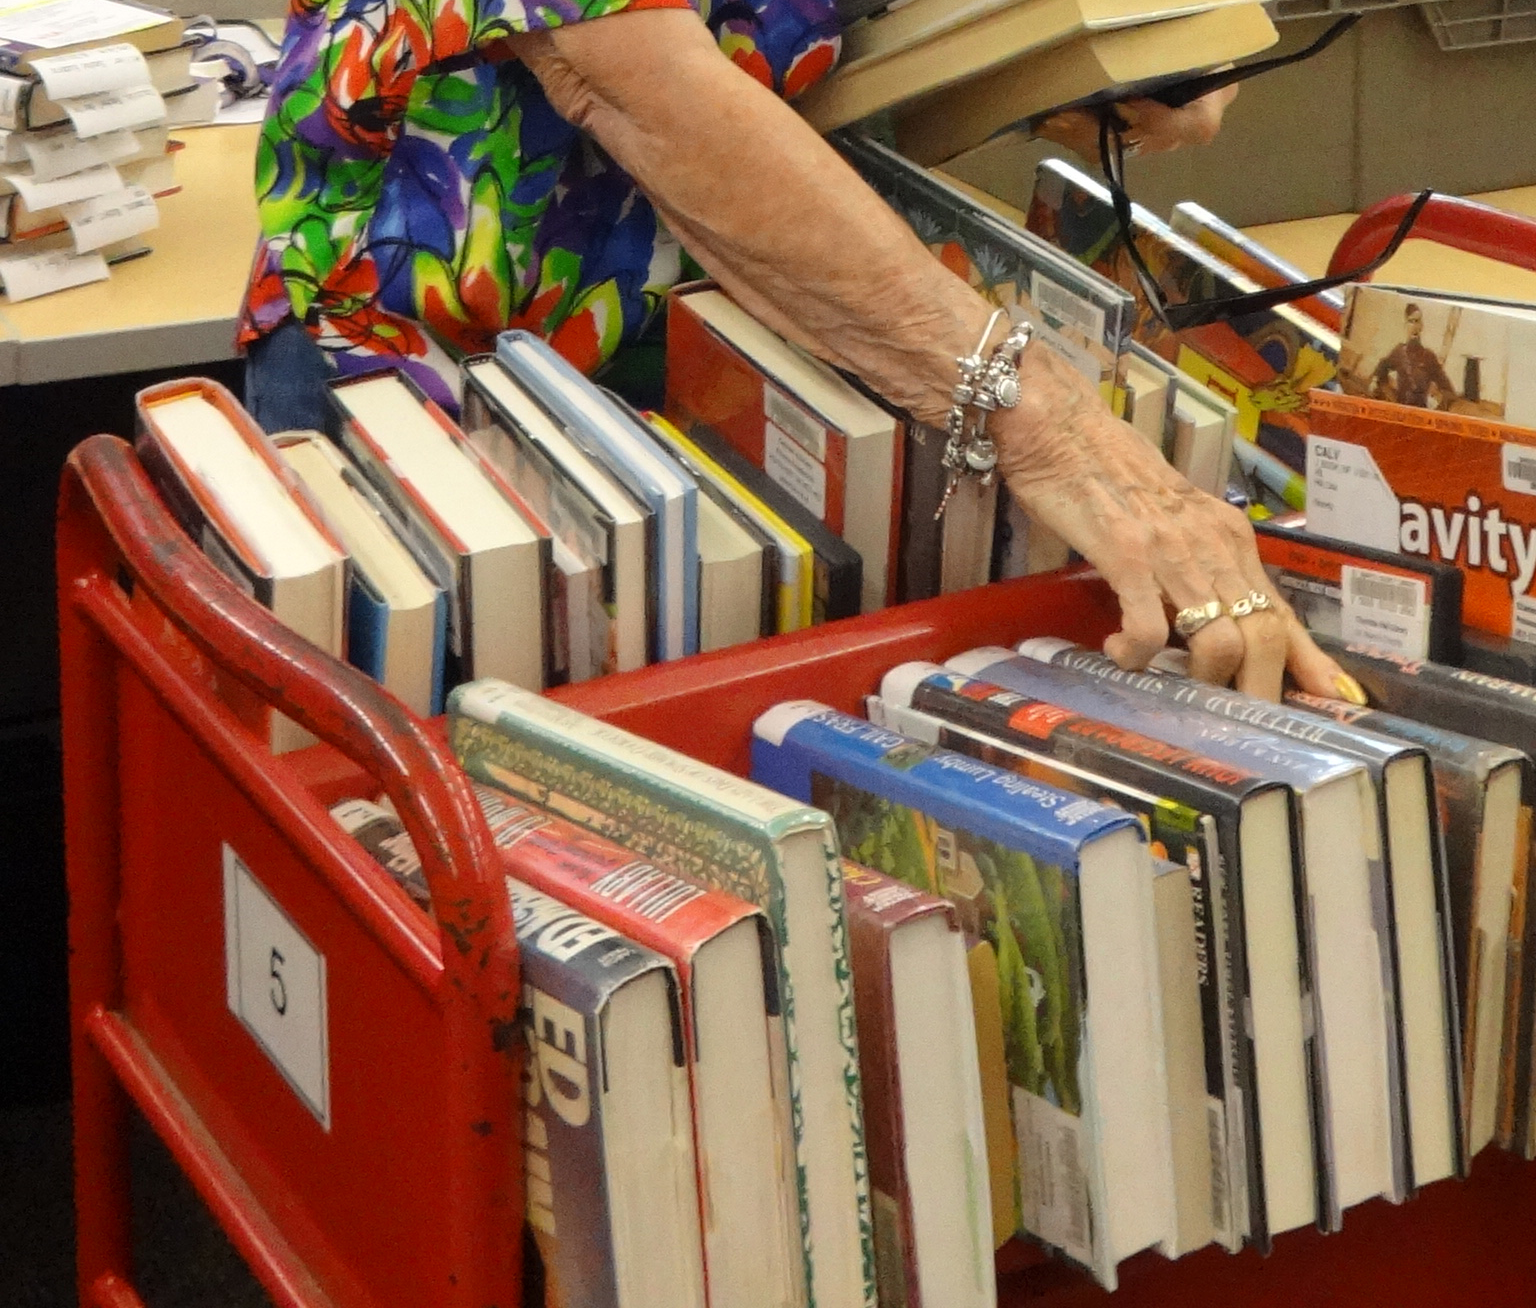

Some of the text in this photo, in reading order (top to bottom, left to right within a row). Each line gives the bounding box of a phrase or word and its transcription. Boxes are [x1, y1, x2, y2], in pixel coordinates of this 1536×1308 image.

[932, 753, 1067, 809] Stealing Lumby
[537, 913, 620, 963] ED
[268, 946, 287, 1017] 5
[534, 990, 592, 1127] ED
